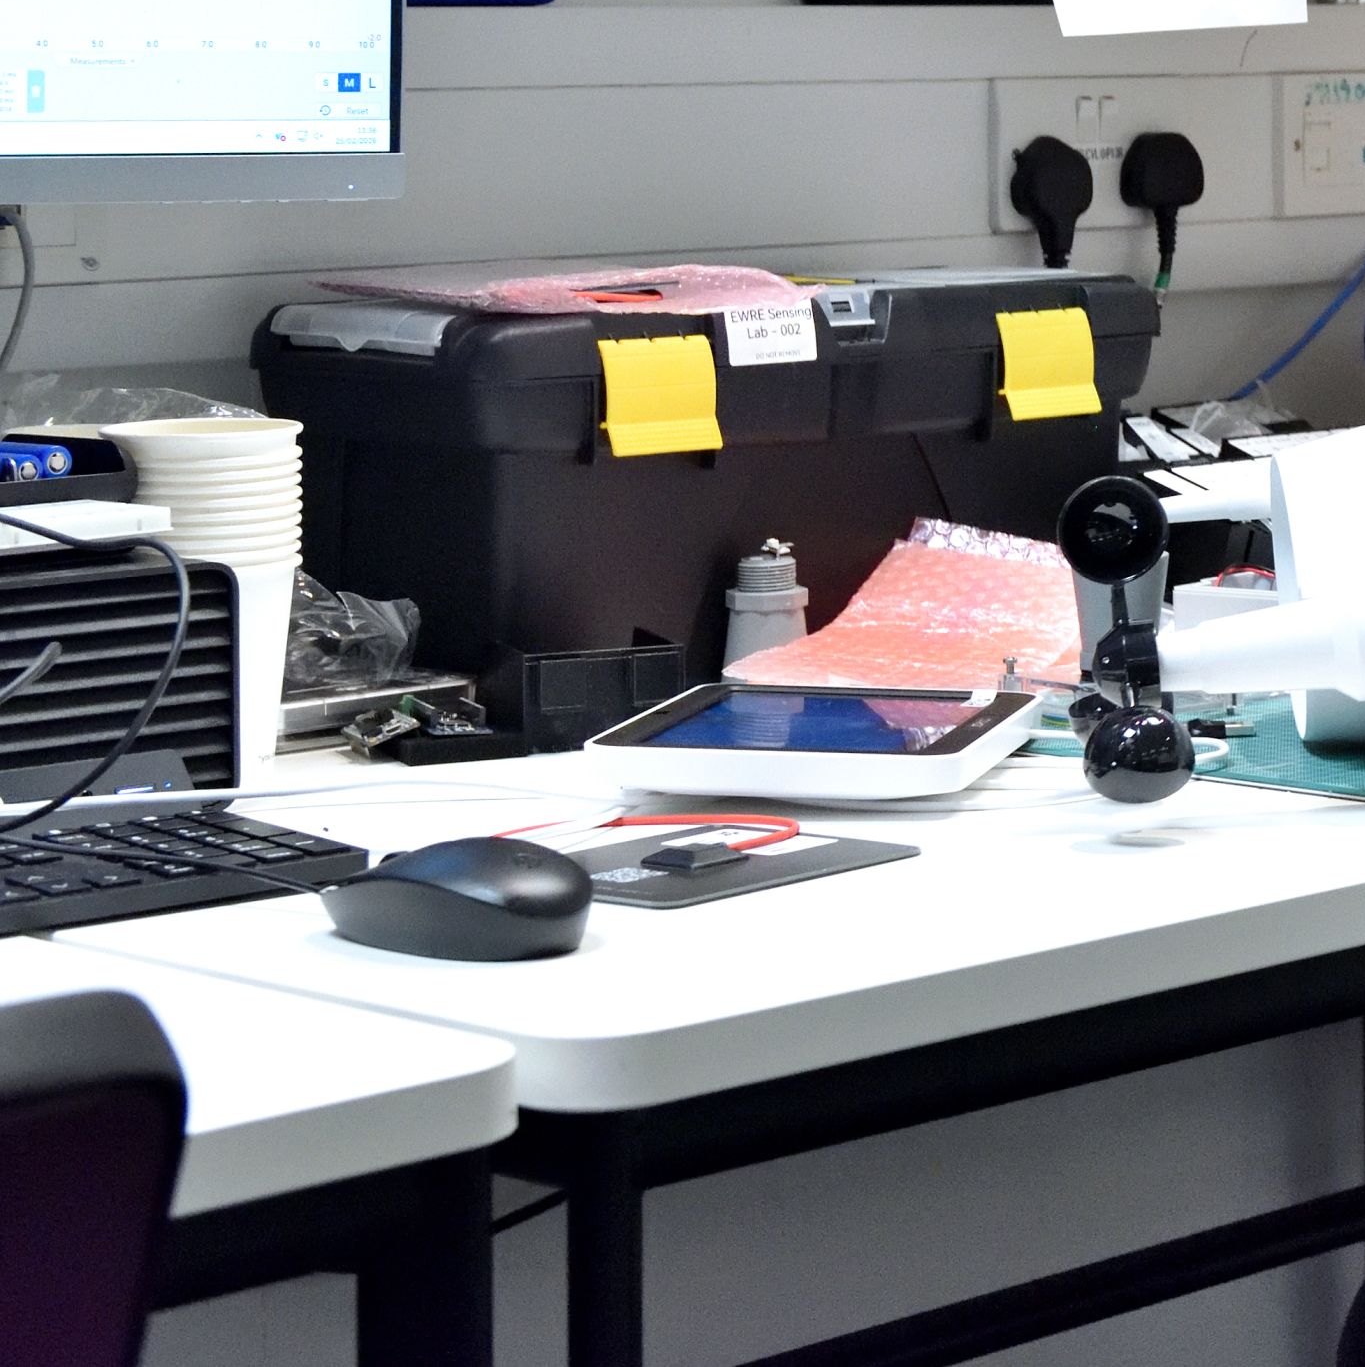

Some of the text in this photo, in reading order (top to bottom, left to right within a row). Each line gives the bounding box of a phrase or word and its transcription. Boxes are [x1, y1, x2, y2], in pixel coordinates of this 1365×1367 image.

[344, 79, 354, 87] M
[368, 77, 376, 89] L
[346, 106, 369, 114] Reset
[730, 307, 812, 323] EWRE Sensing
[747, 325, 768, 339] Lab
[780, 323, 801, 336] 002
